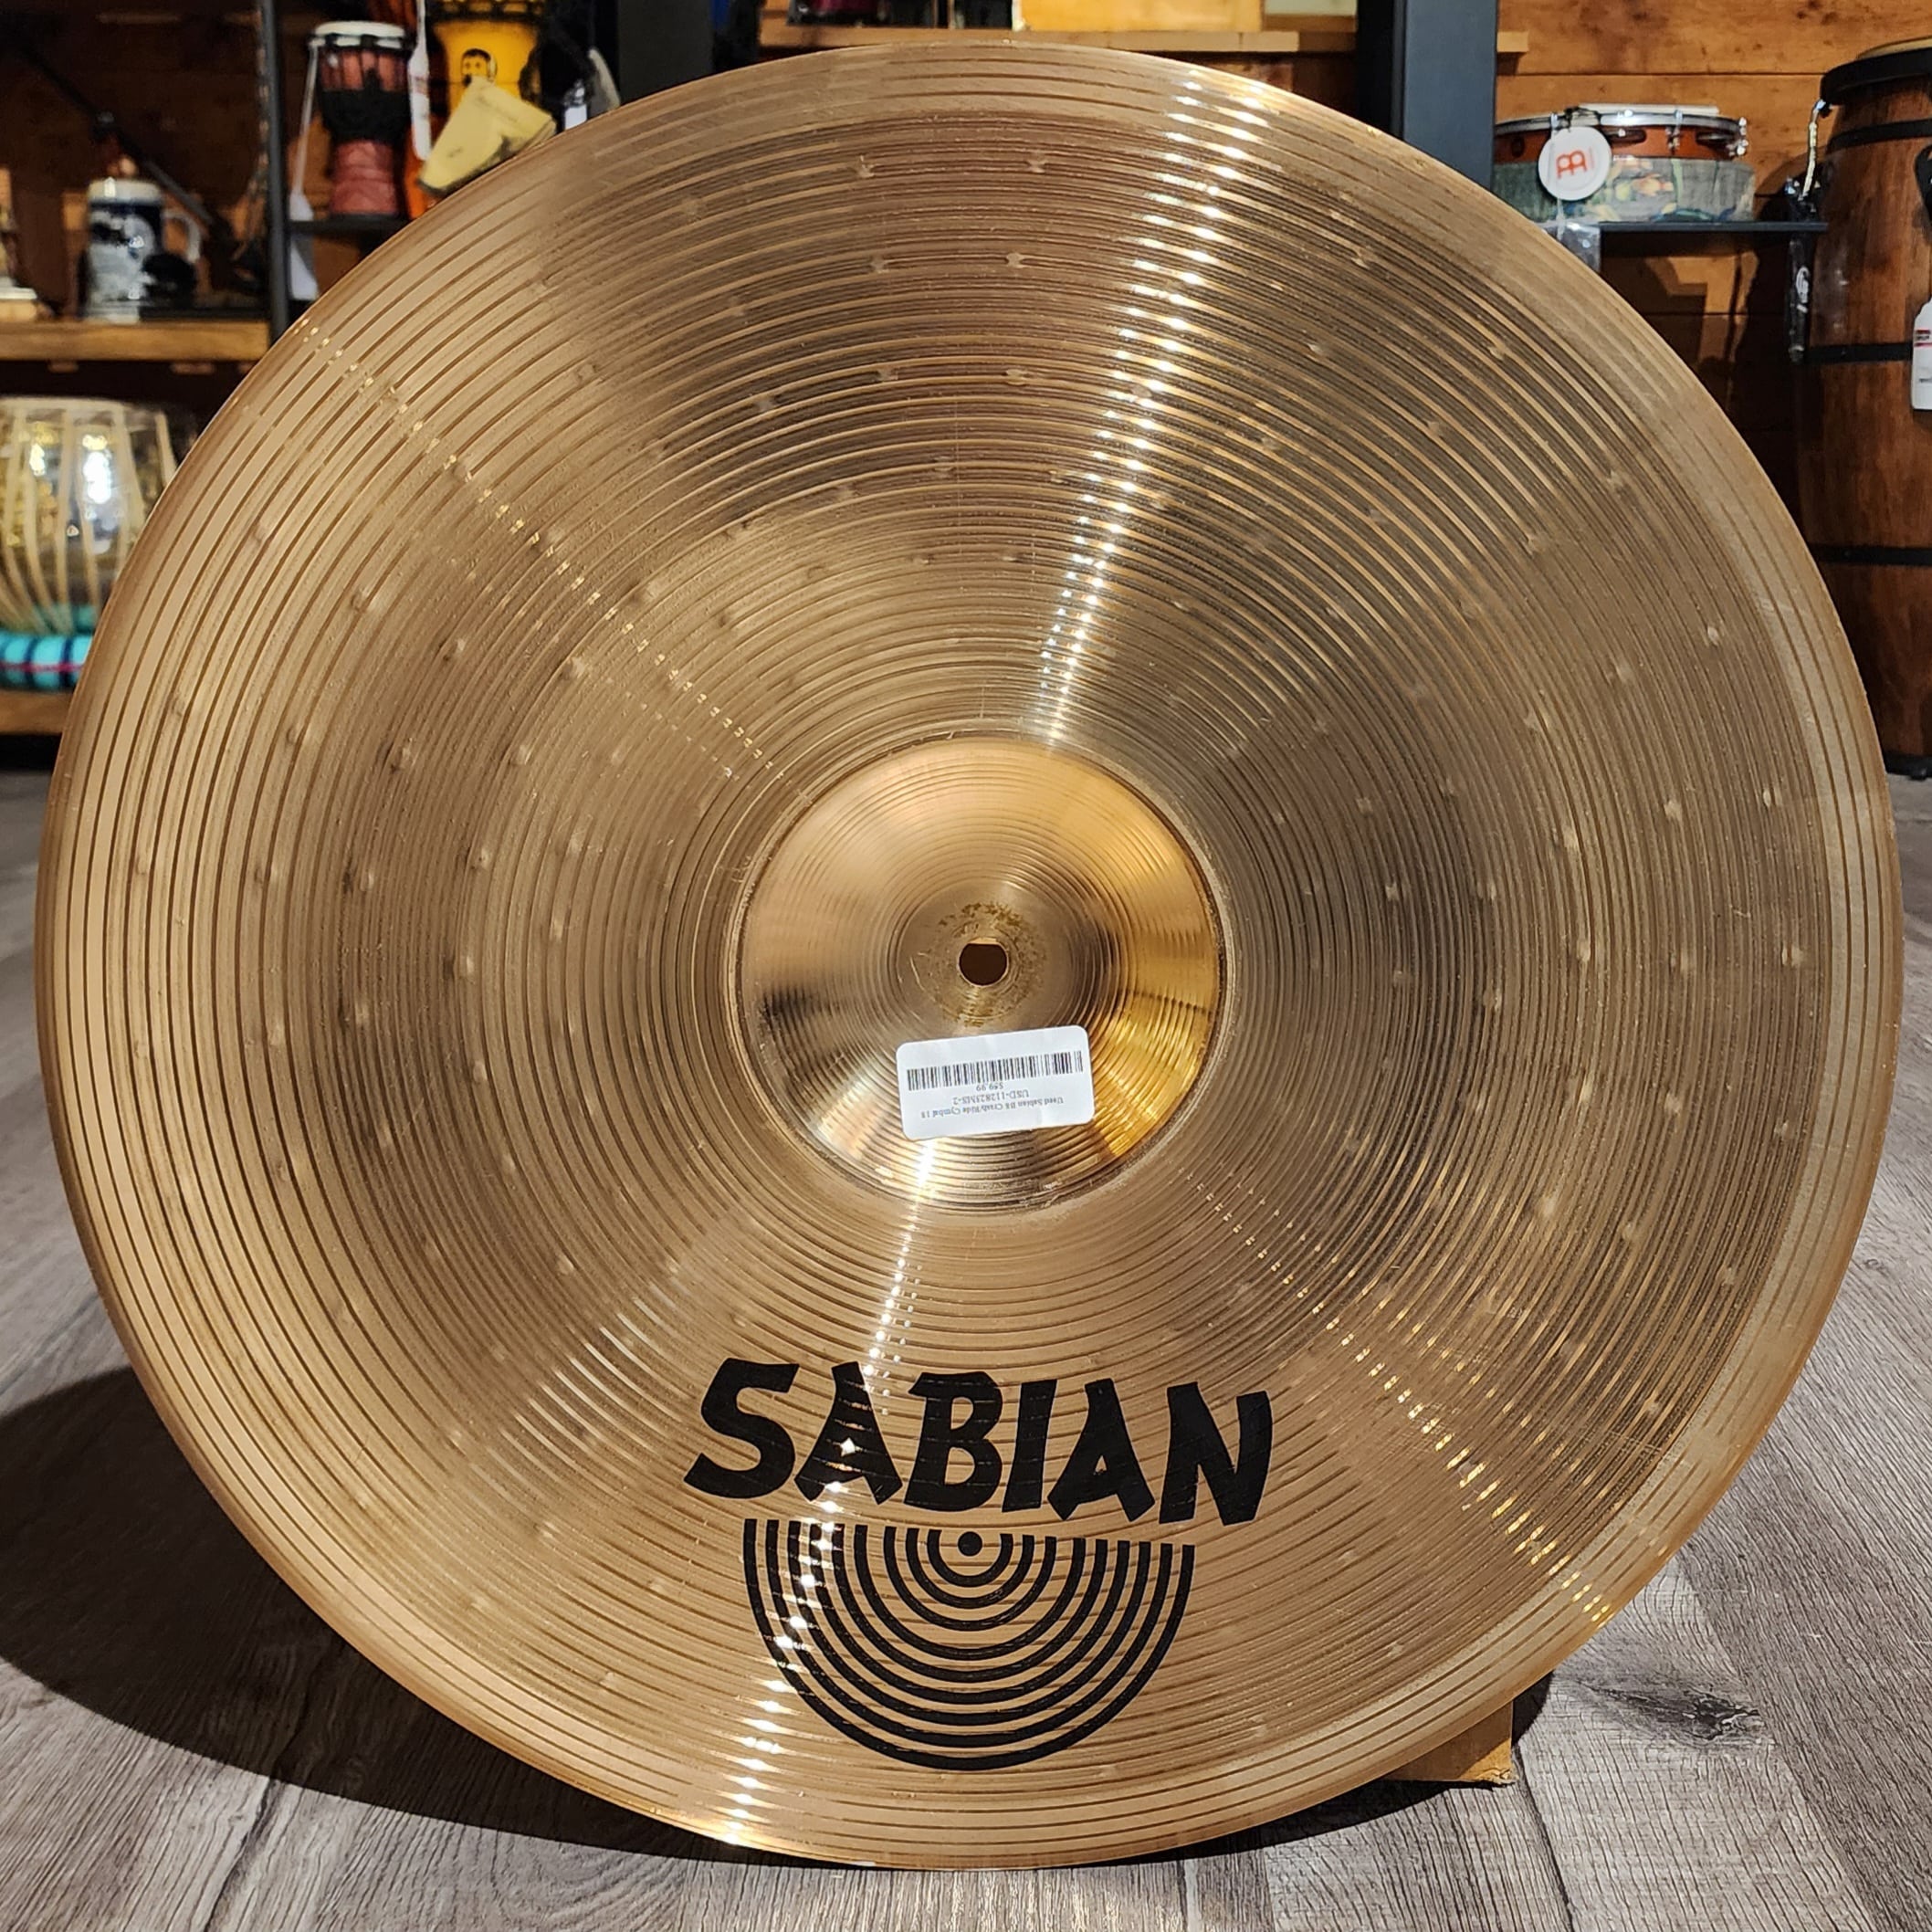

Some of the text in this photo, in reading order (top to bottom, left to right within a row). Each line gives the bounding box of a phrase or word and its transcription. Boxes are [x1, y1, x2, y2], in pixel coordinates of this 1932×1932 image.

[1017, 1098, 1043, 1108] Sabian
[1044, 1097, 1064, 1105] Used
[932, 1107, 961, 1118] Cymbal
[683, 1358, 1273, 1526] SABIAN
